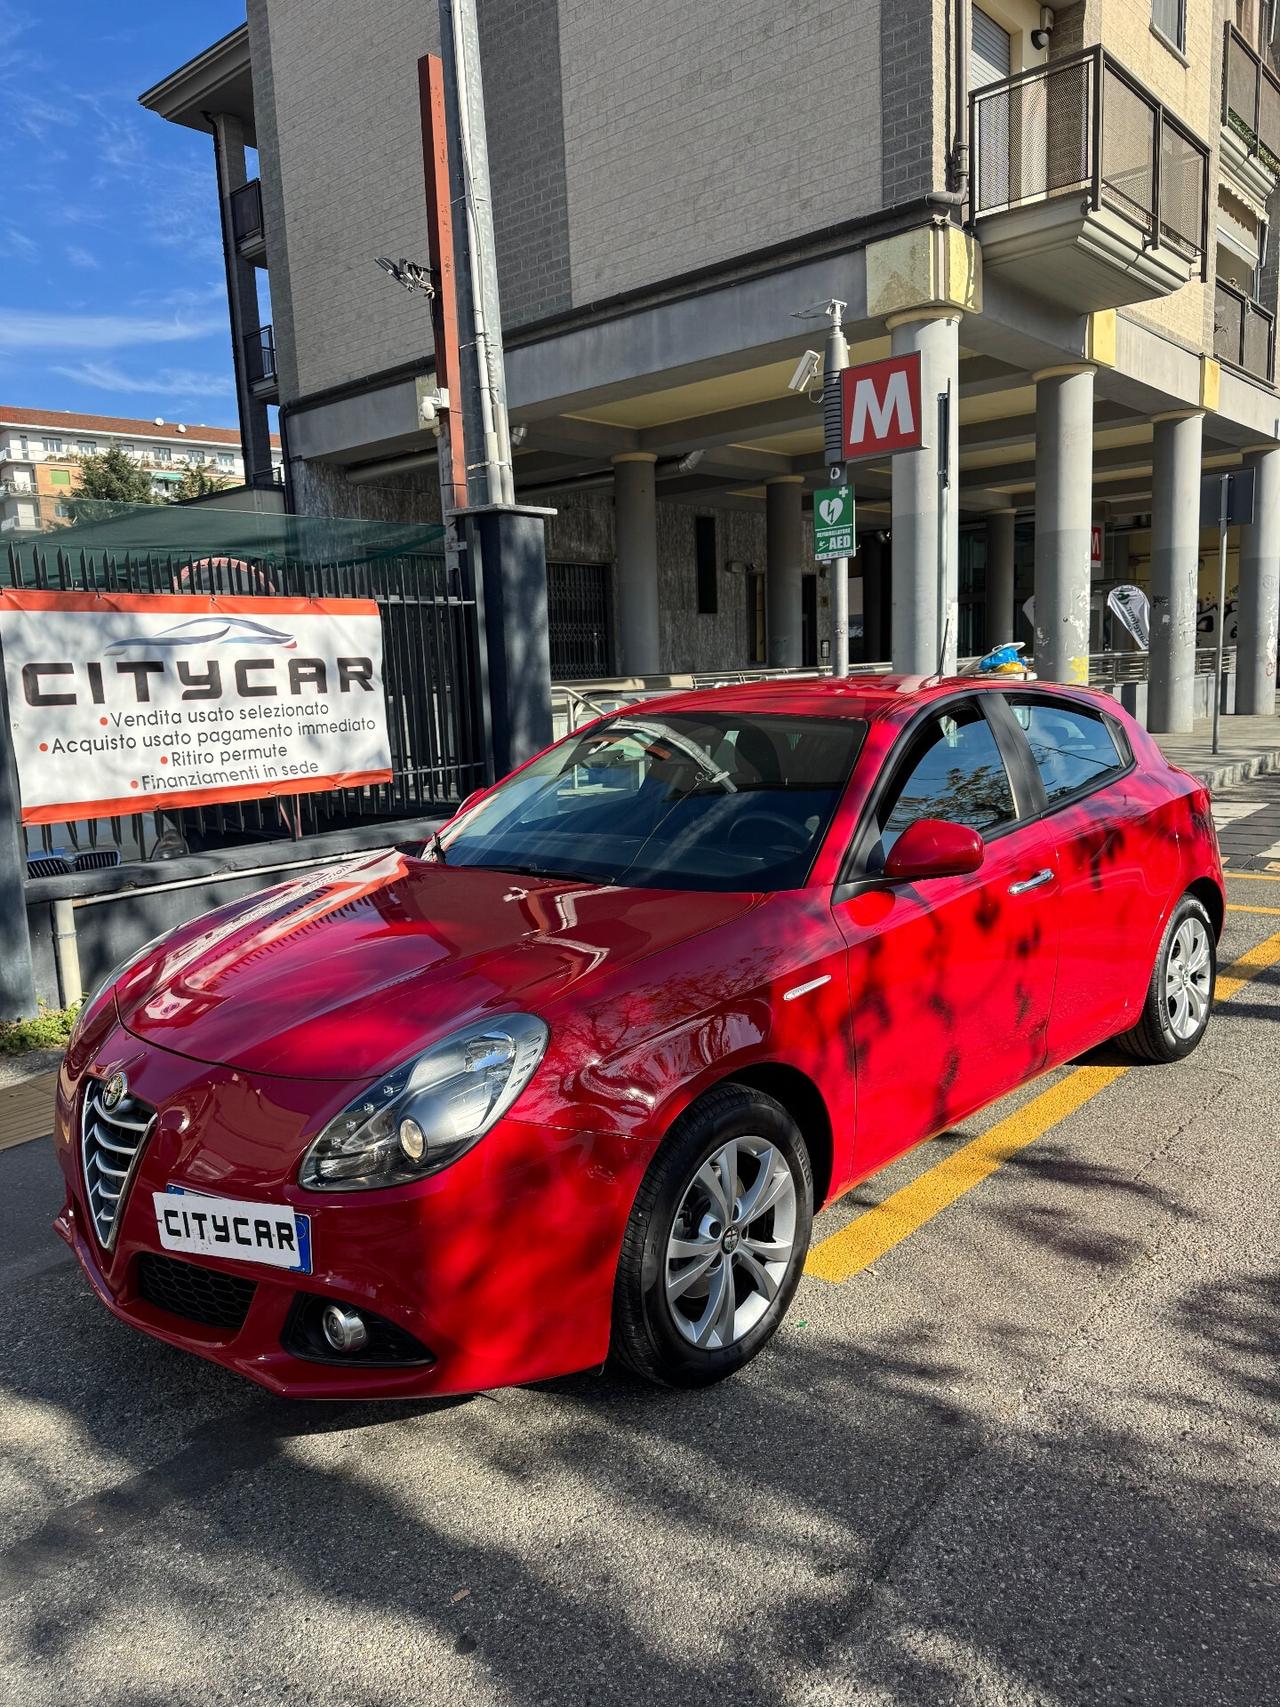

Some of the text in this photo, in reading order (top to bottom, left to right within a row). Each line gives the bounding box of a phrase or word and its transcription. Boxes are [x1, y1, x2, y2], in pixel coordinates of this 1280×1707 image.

[850, 370, 915, 444] M
[828, 535, 851, 550] AED
[22, 657, 375, 707] CITYCAR
[110, 701, 329, 728] Vendita usato selezionato
[51, 718, 376, 755] Acquisto usato pagamento immediato
[171, 744, 288, 767] Ritiro permute
[141, 760, 319, 791] Finanziamenti in sede
[163, 1209, 296, 1252] CITYCAR
